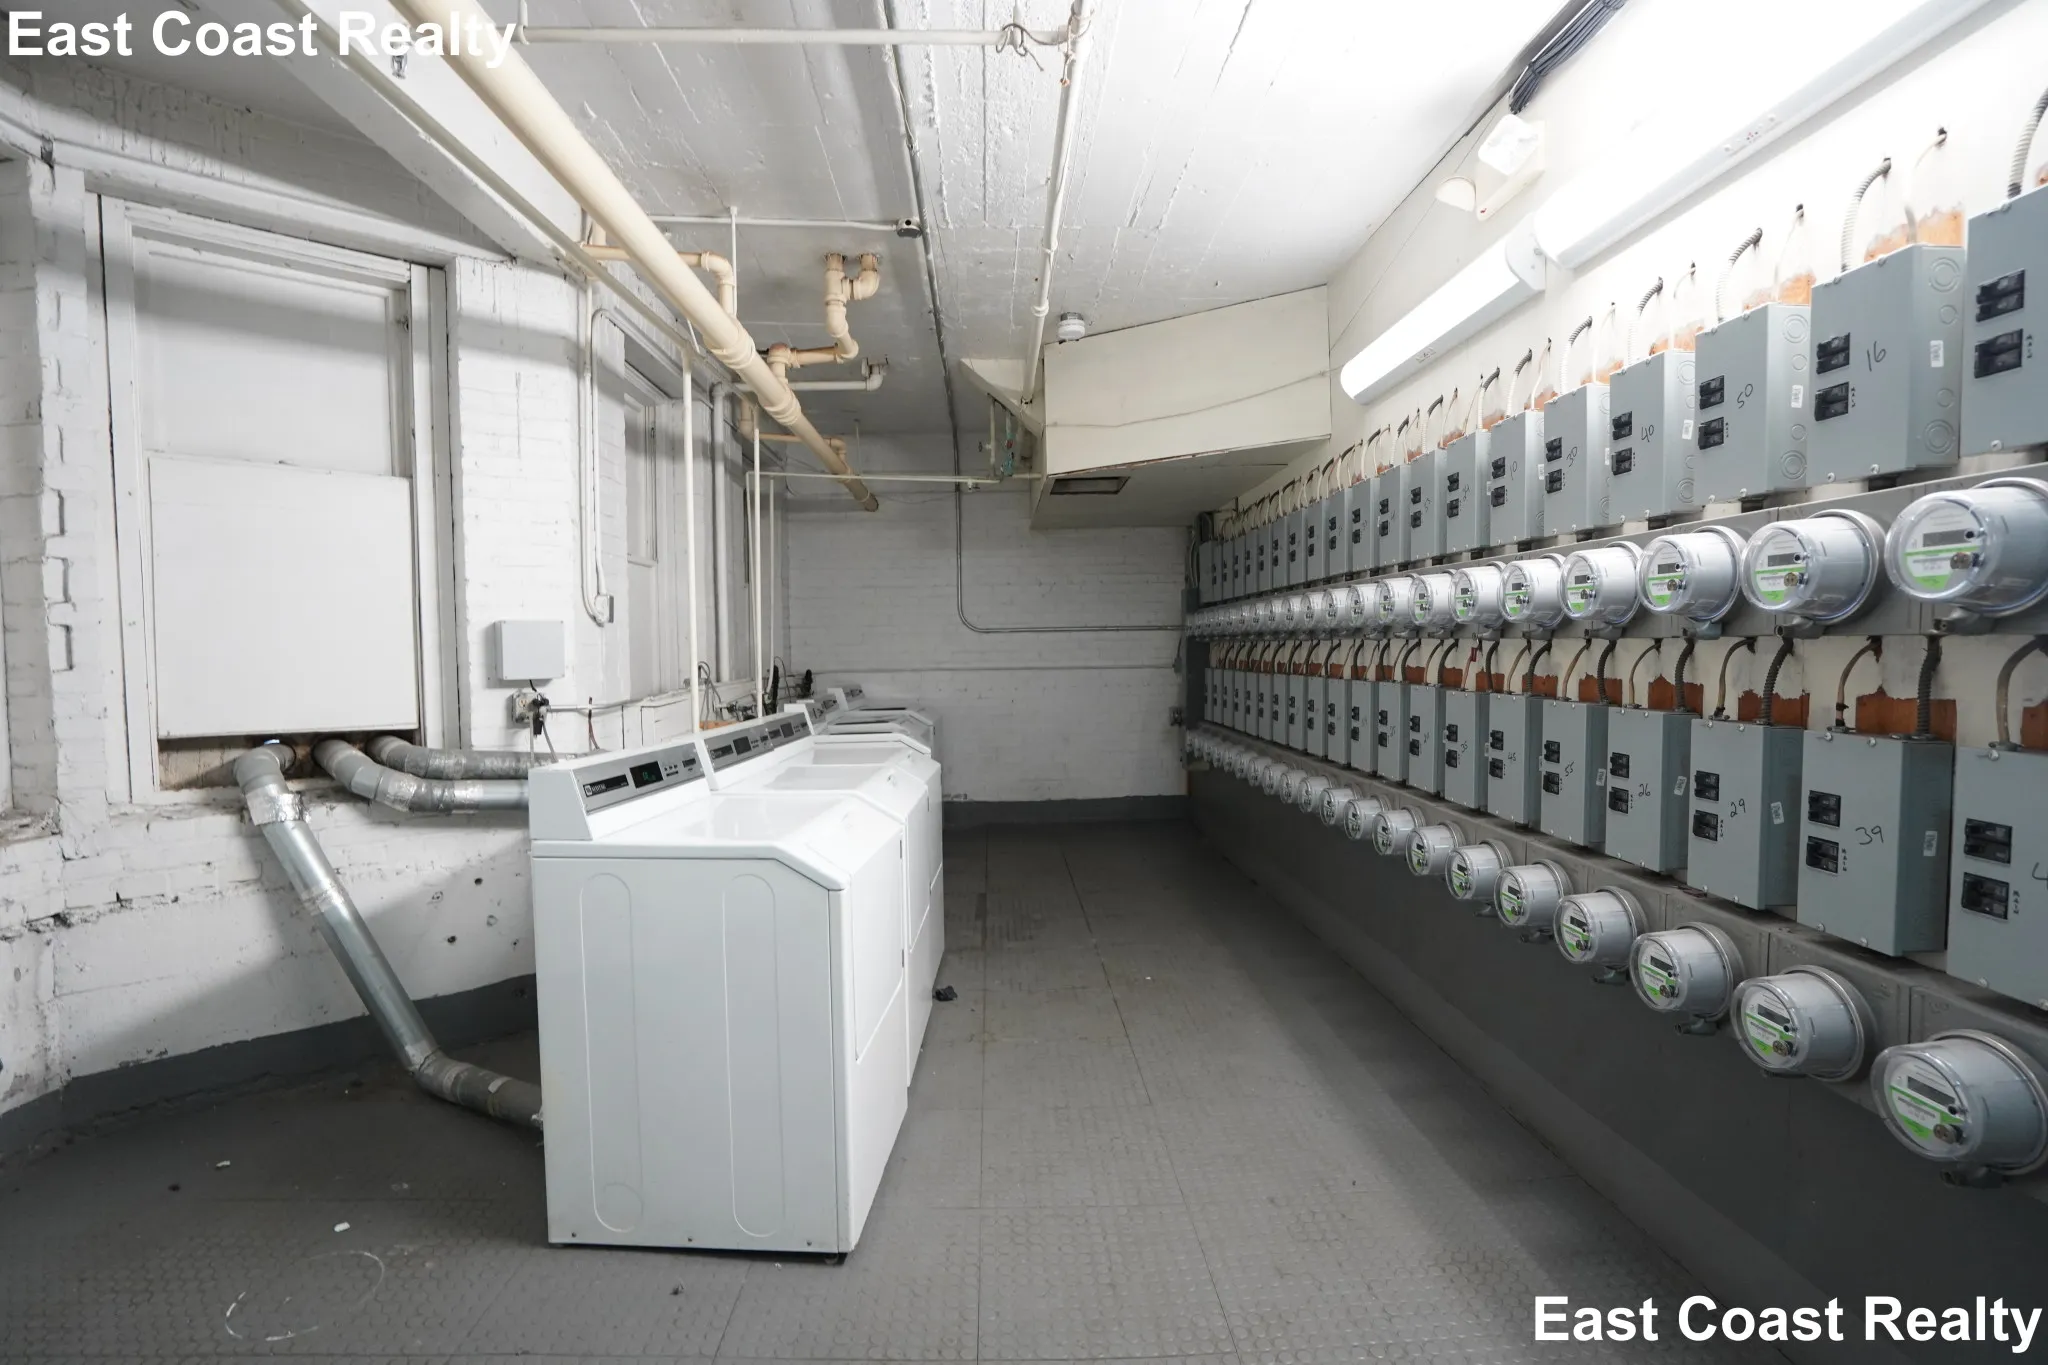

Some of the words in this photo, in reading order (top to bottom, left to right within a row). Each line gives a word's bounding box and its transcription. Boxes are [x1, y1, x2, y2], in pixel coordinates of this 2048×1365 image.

[1866, 341, 1887, 372] 16
[1736, 383, 1754, 409] 50
[1640, 424, 1655, 443] 40
[1566, 446, 1578, 467] 30
[1564, 760, 1575, 777] 55
[1638, 783, 1651, 797] 26
[1729, 798, 1746, 818] 29
[1855, 825, 1884, 845] 39
